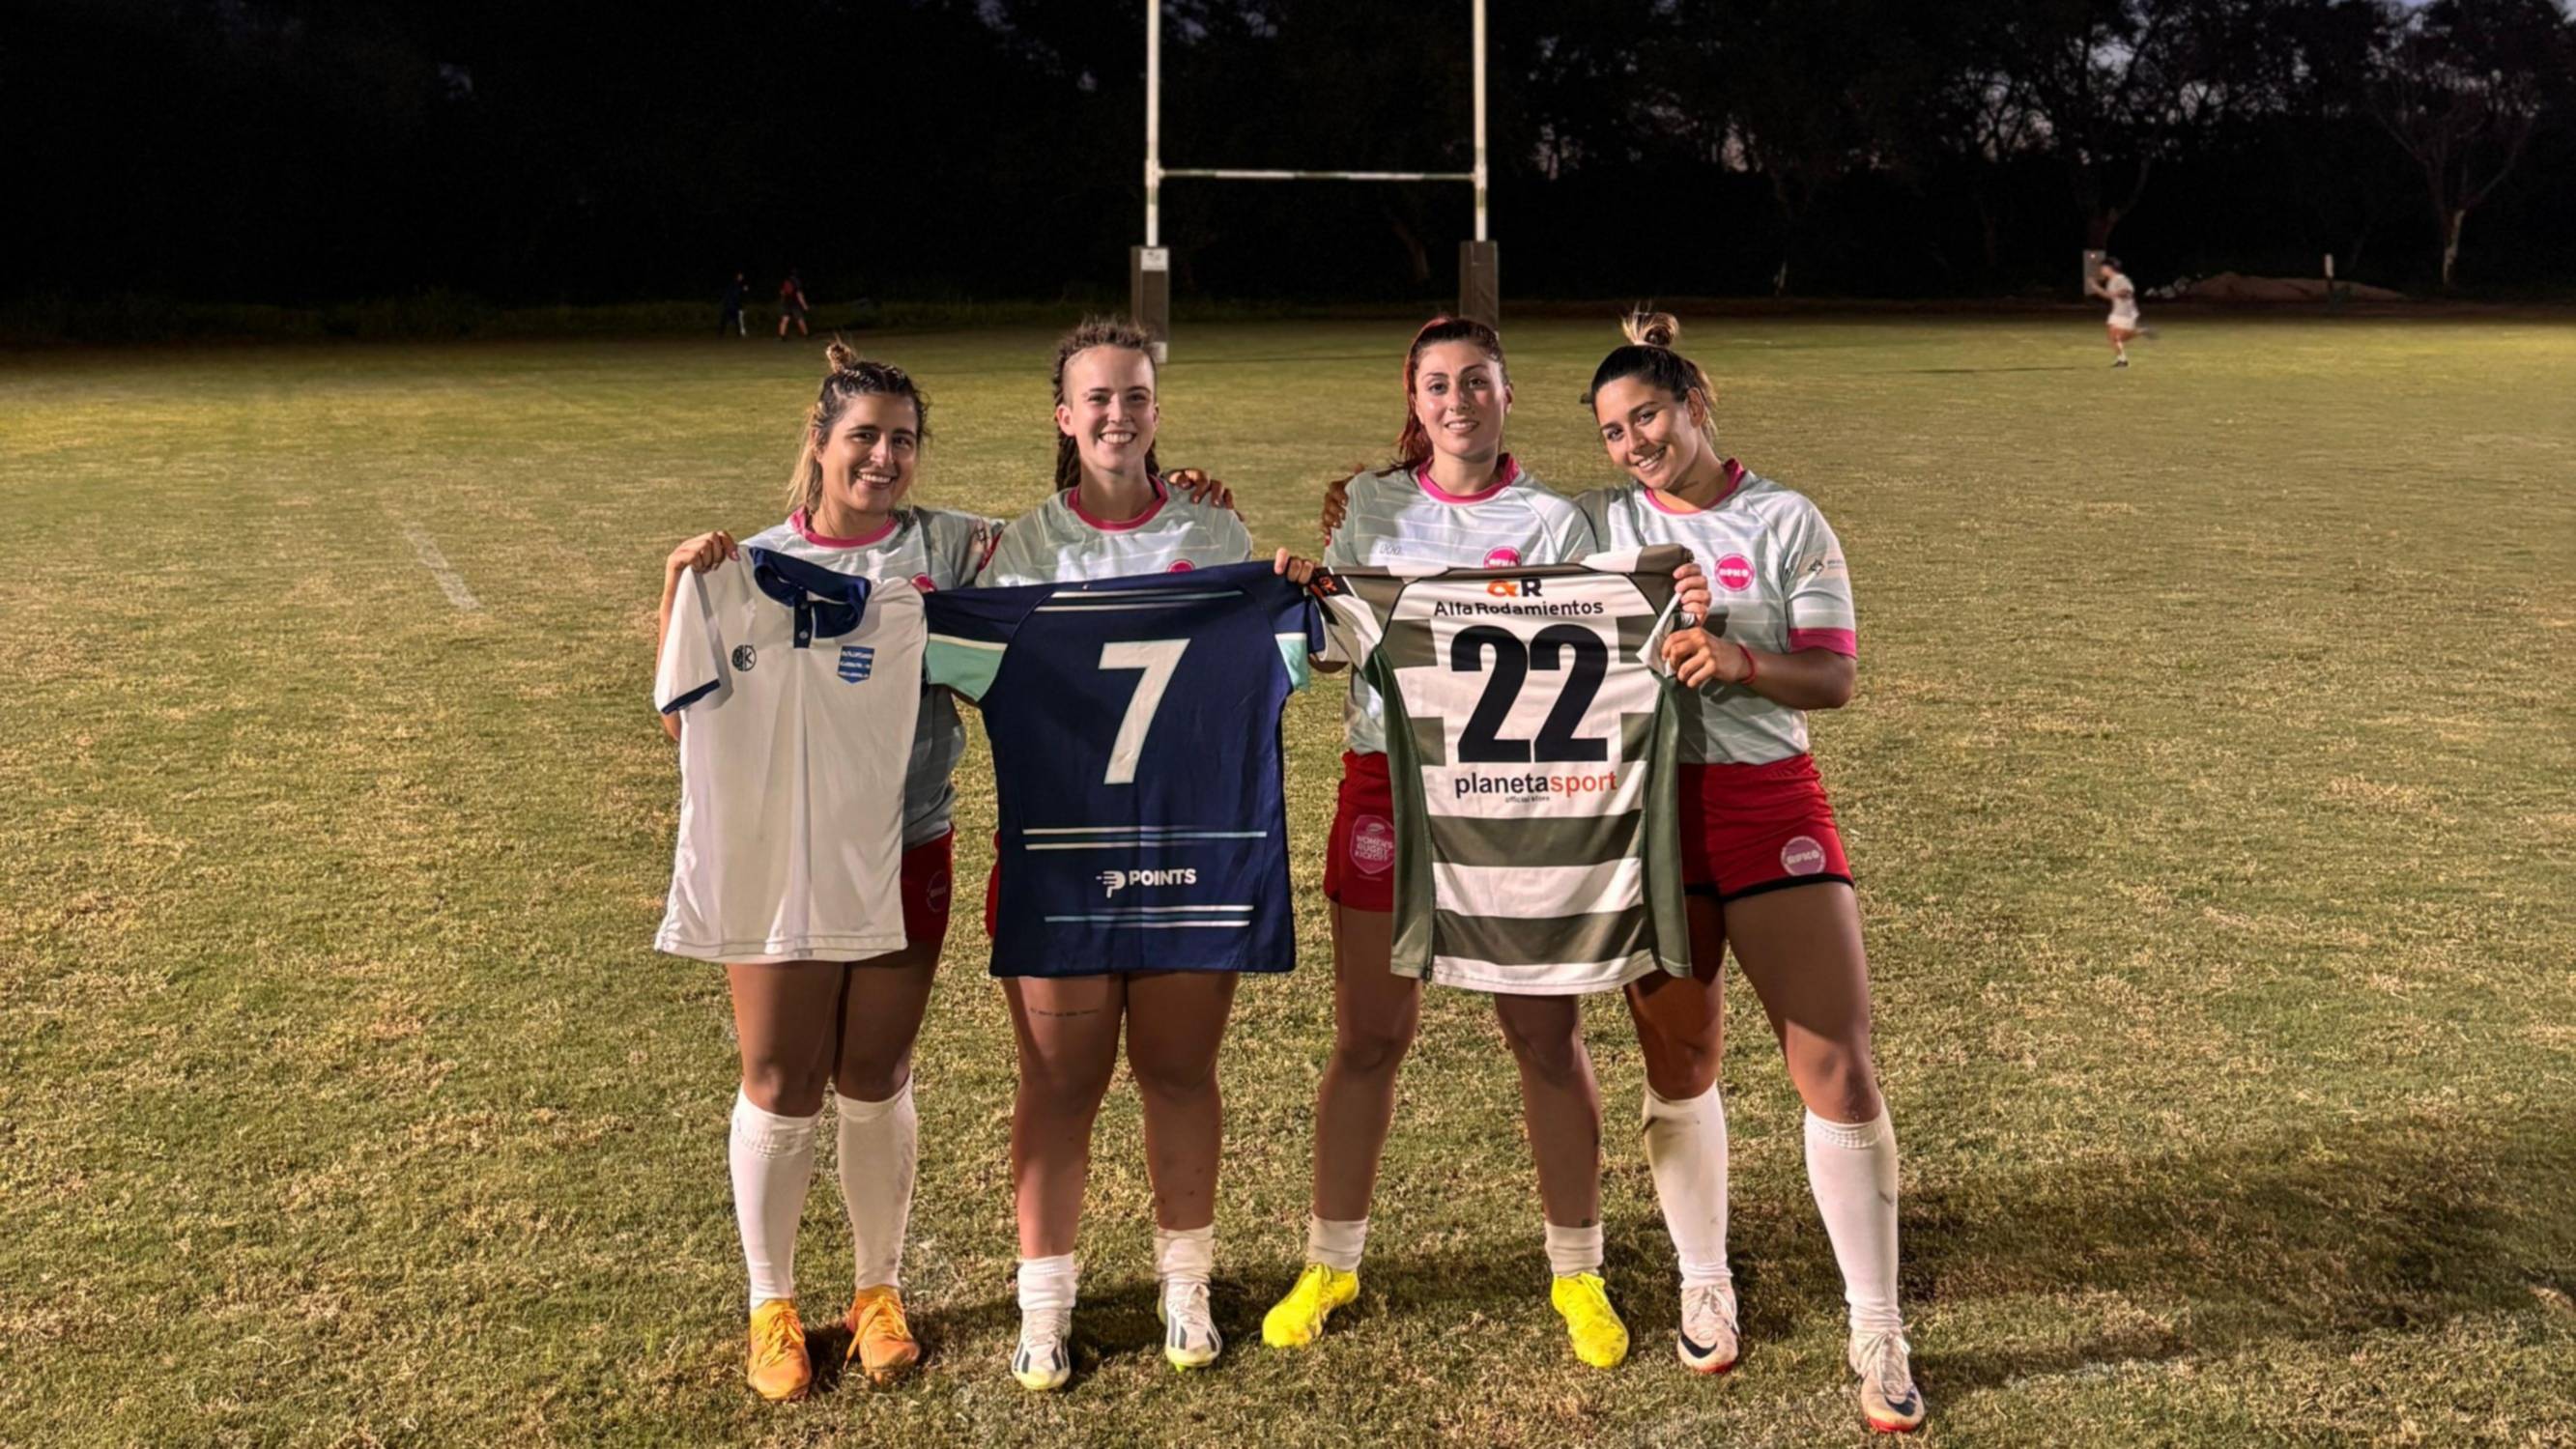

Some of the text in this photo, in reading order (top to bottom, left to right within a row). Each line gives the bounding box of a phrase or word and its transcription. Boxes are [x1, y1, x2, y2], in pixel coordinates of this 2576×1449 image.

[1098, 639, 1190, 785] 7
[1450, 623, 1609, 763] 22
[1454, 771, 1617, 799] planetasport
[1129, 868, 1197, 887] POINTS
